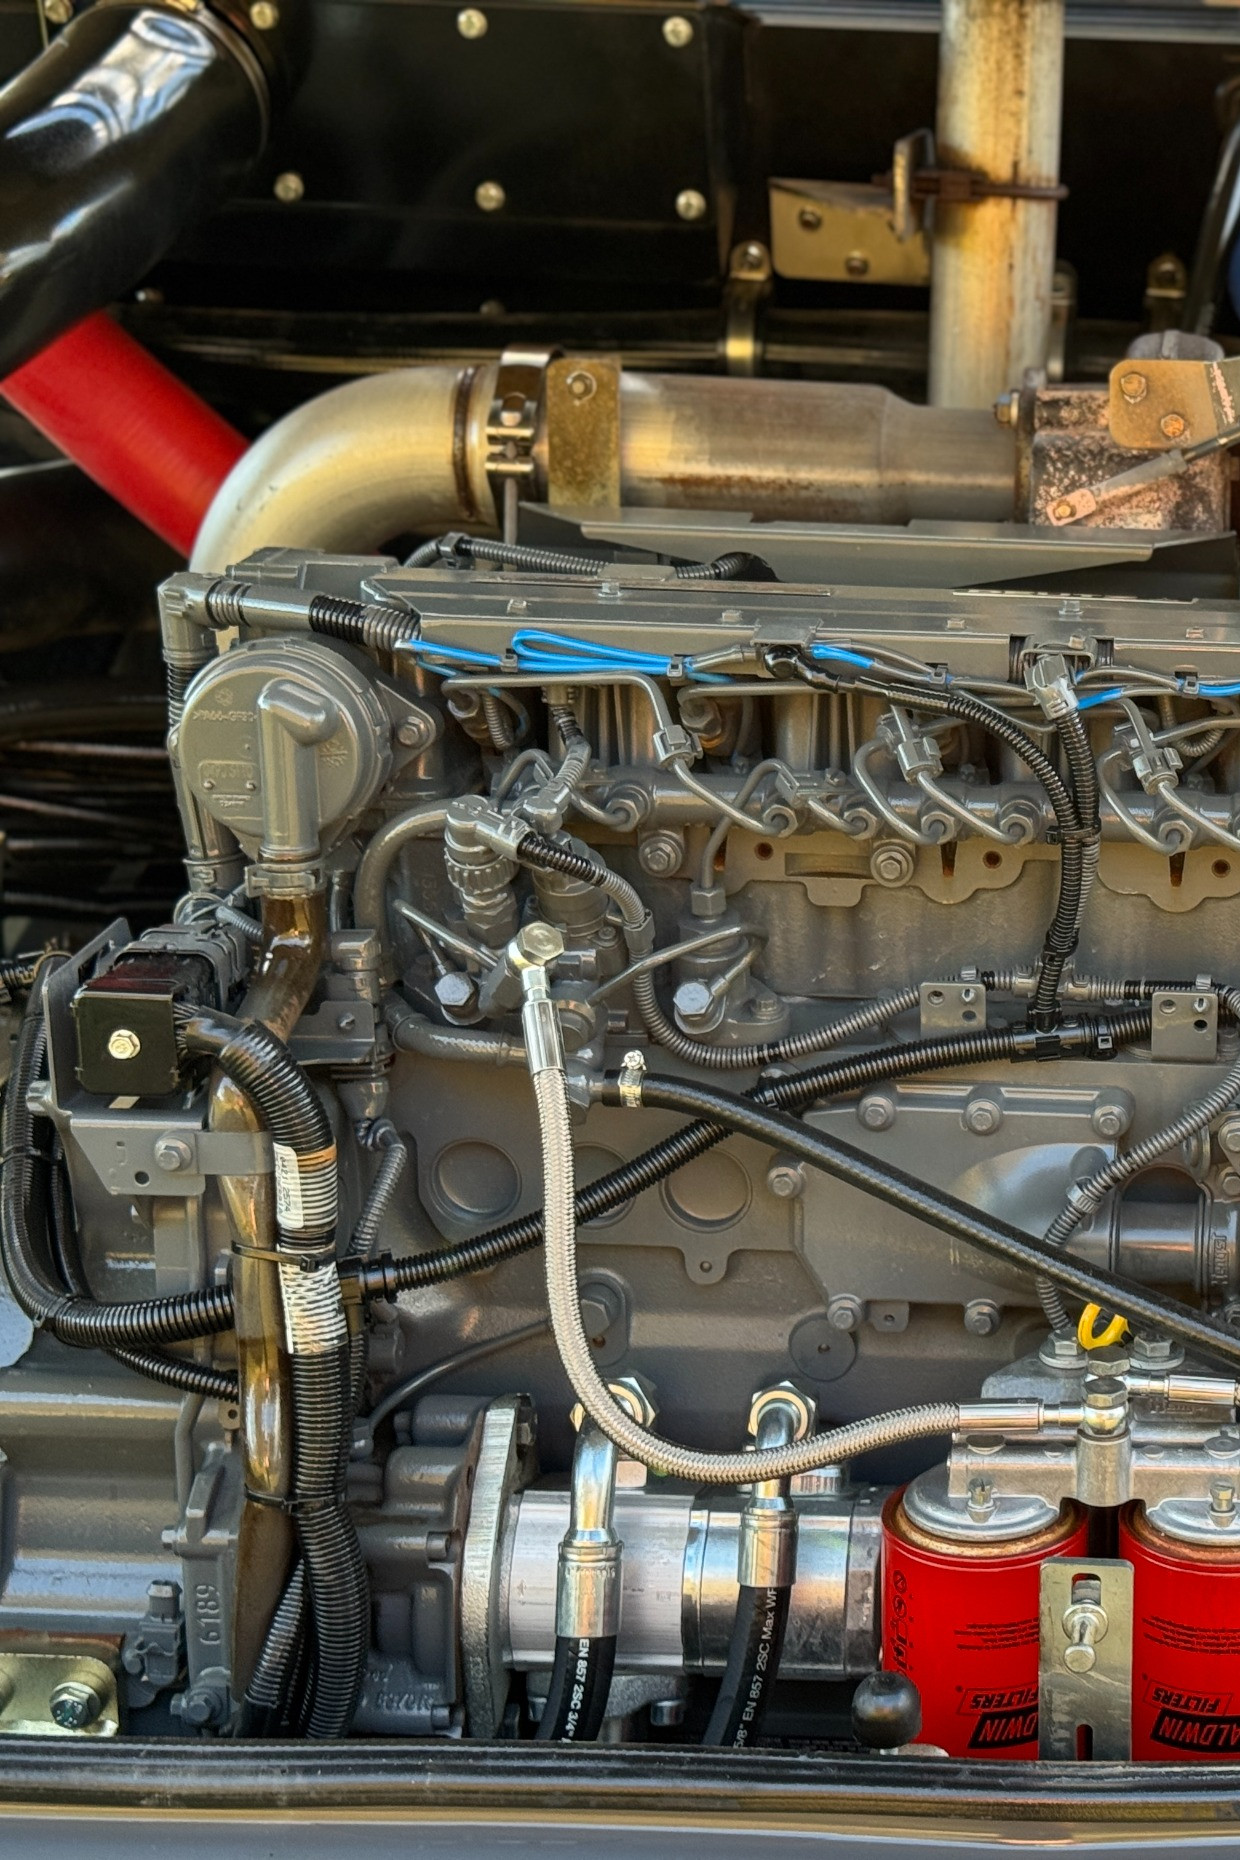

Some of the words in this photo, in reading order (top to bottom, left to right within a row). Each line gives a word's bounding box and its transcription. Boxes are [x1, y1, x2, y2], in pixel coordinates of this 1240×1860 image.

[761, 1609, 775, 1640] Max
[578, 1638, 590, 1658] EN
[756, 1642, 770, 1671] 2SC
[573, 1658, 589, 1683] 857
[571, 1684, 585, 1710] 2SC
[749, 1675, 763, 1699] 857
[970, 1688, 1038, 1710] FILTERS
[742, 1701, 757, 1721] EN
[1151, 1687, 1221, 1714] FILTERS
[978, 1712, 1038, 1741] DWIN
